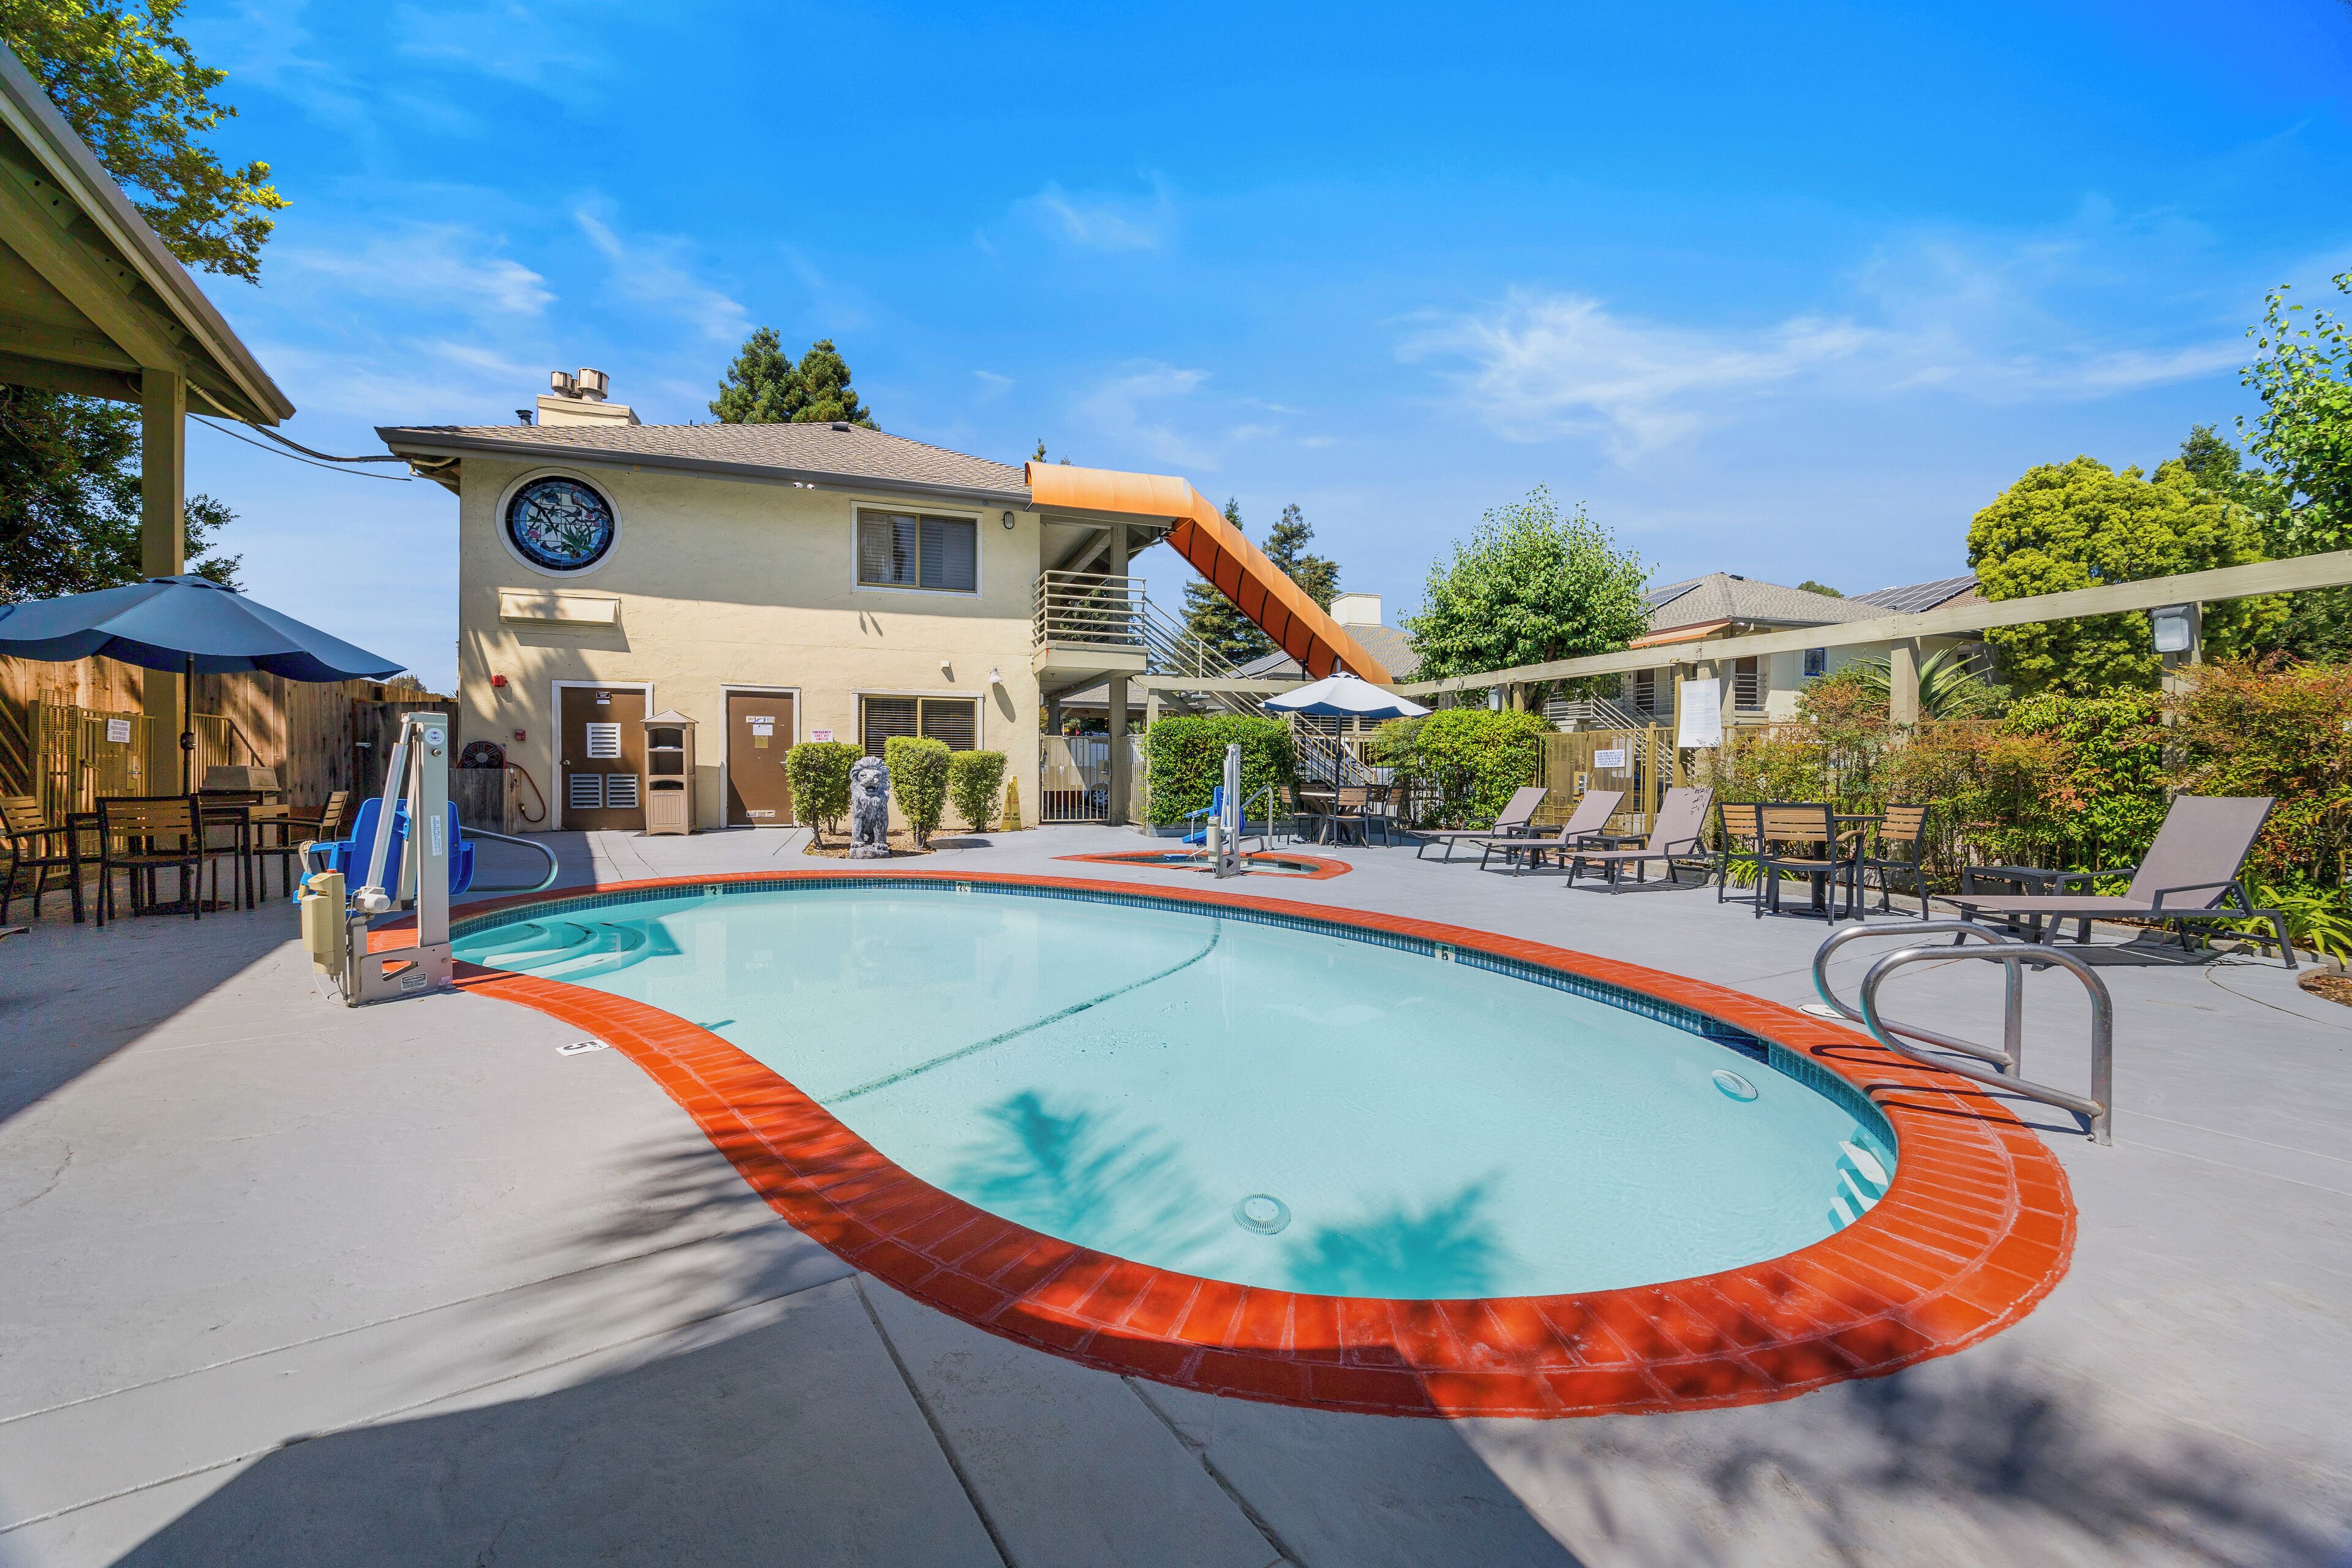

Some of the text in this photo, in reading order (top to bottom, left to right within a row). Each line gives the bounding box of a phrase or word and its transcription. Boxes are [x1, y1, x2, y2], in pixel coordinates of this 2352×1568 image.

[1441, 945, 1449, 960] 5
[404, 974, 425, 982] WARNING
[563, 1041, 598, 1050] 5
